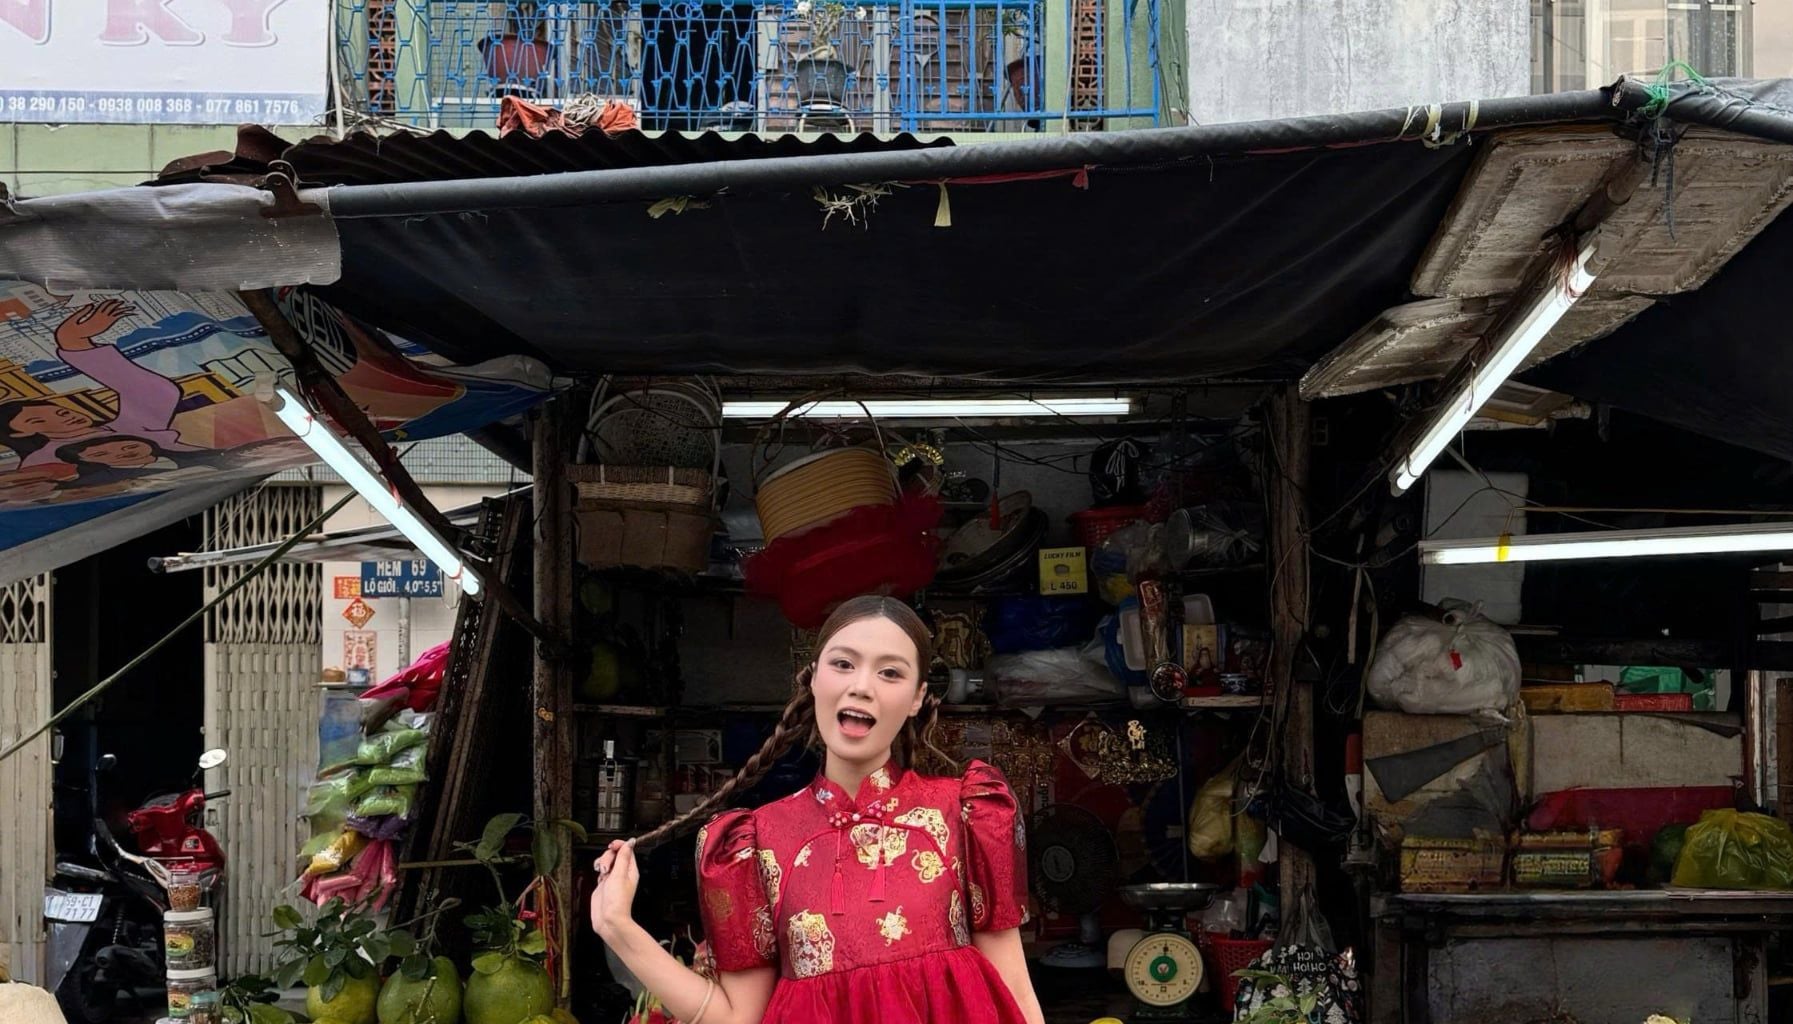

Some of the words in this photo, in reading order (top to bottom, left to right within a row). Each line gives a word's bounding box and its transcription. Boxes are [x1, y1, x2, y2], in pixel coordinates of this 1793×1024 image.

[8, 96, 26, 111] 38
[30, 96, 55, 111] 290
[98, 98, 133, 112] 0938
[137, 98, 162, 112] 008
[206, 99, 231, 113] 077
[235, 99, 259, 113] 861
[264, 100, 298, 114] 7576
[411, 560, 427, 576] 69
[1060, 581, 1077, 590] 450
